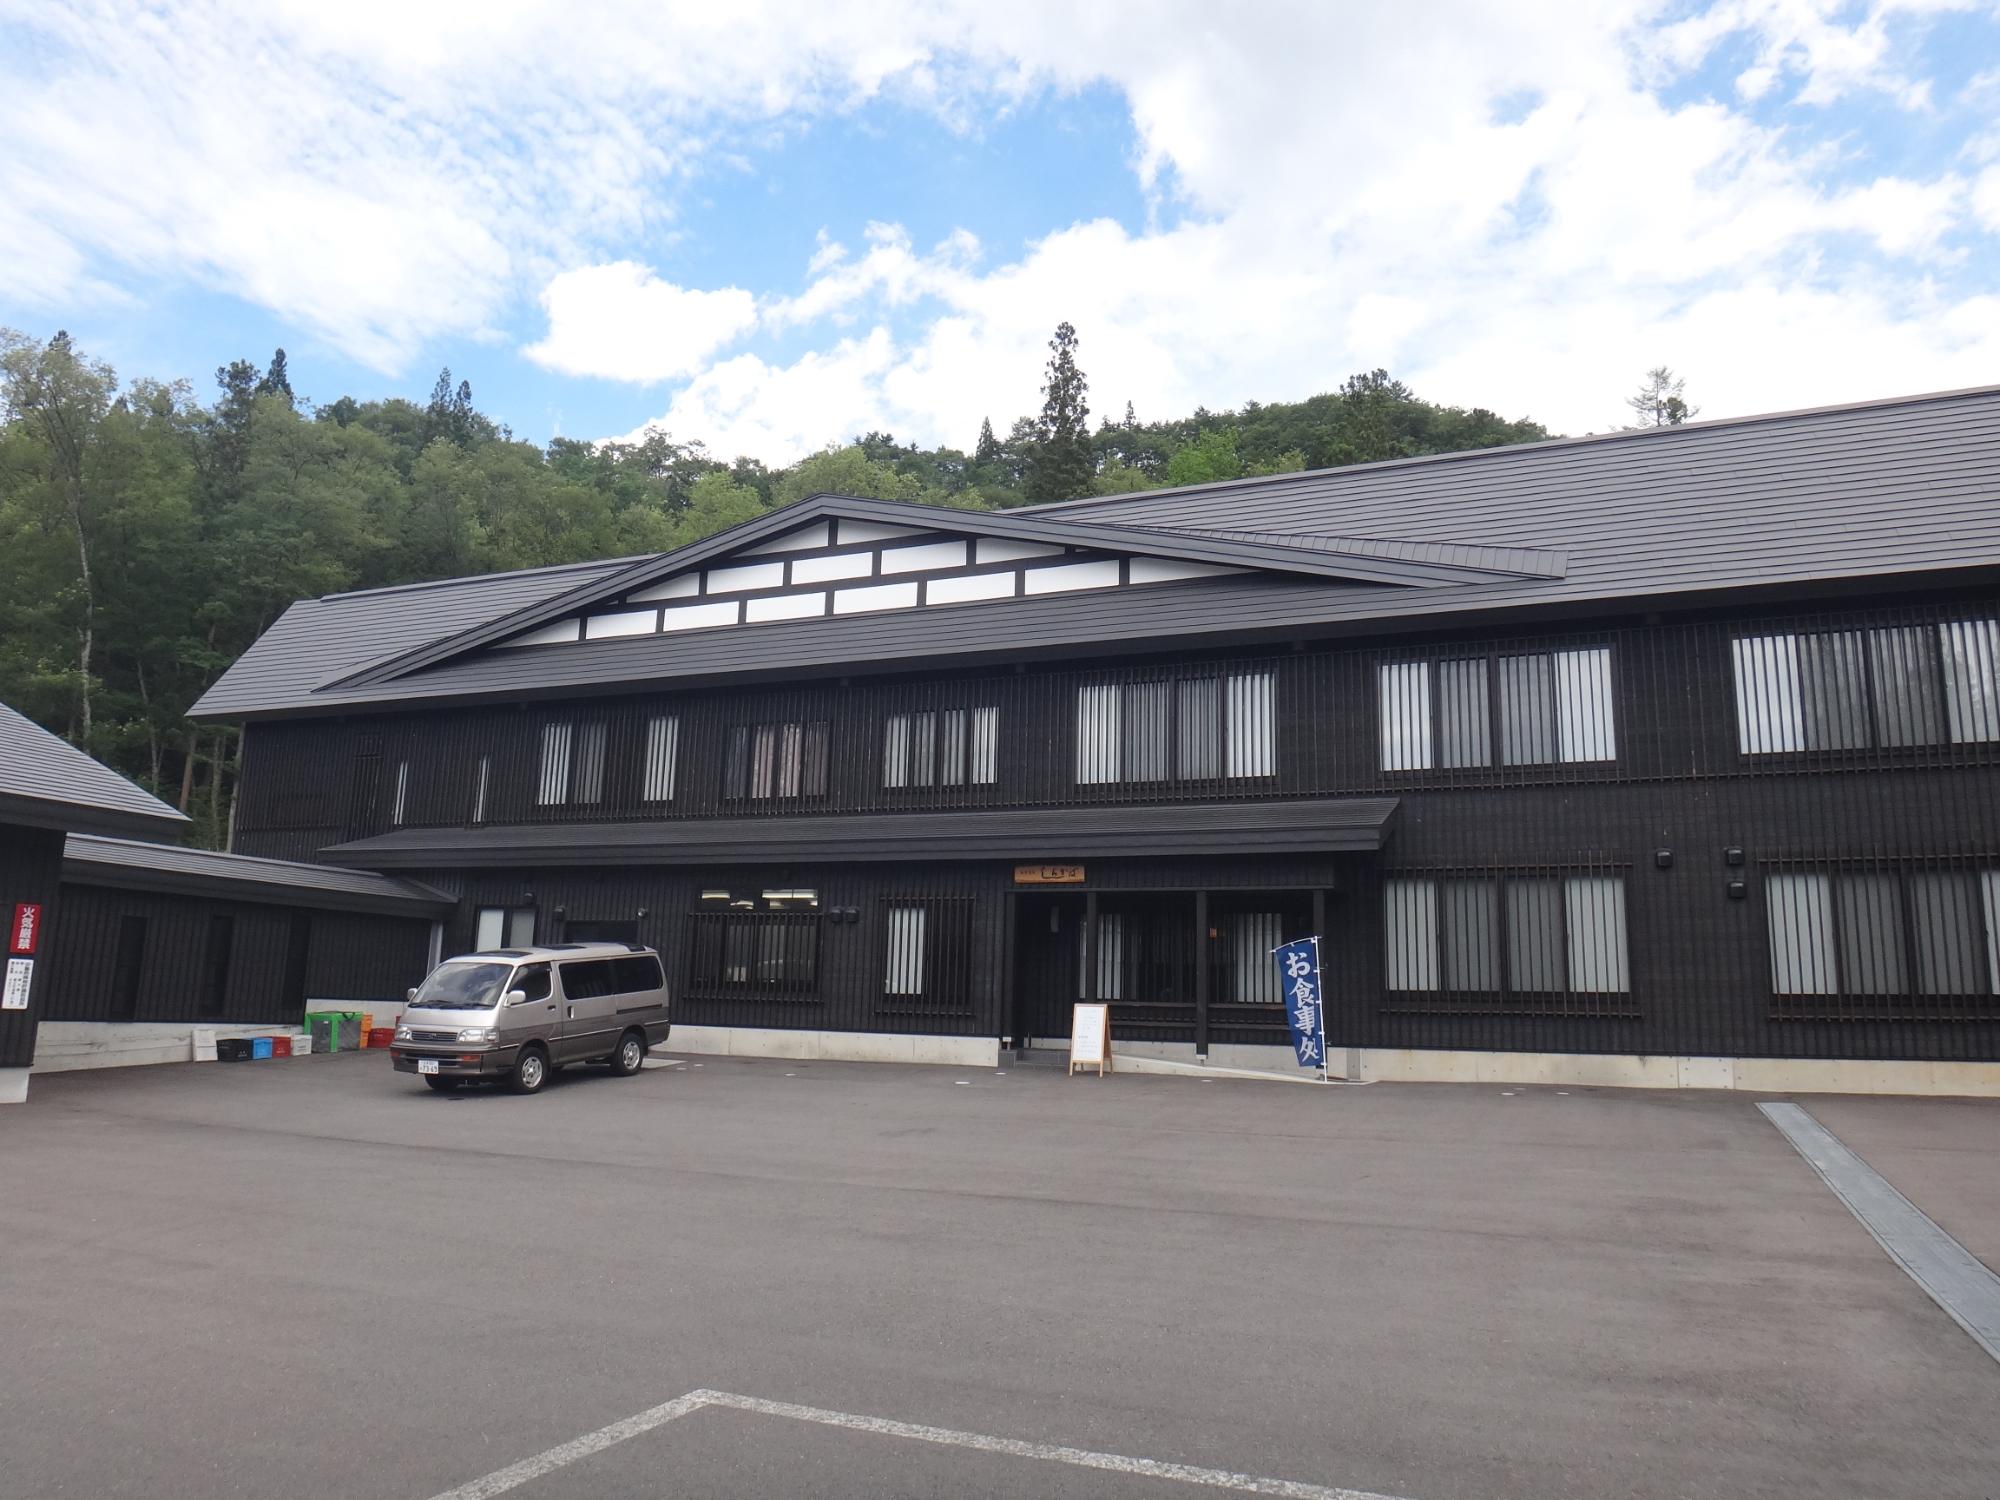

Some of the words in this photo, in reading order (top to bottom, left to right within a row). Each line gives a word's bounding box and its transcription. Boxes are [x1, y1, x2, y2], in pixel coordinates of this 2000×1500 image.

[17, 906, 35, 949] 火気厳禁
[1286, 952, 1320, 1062] お食事処
